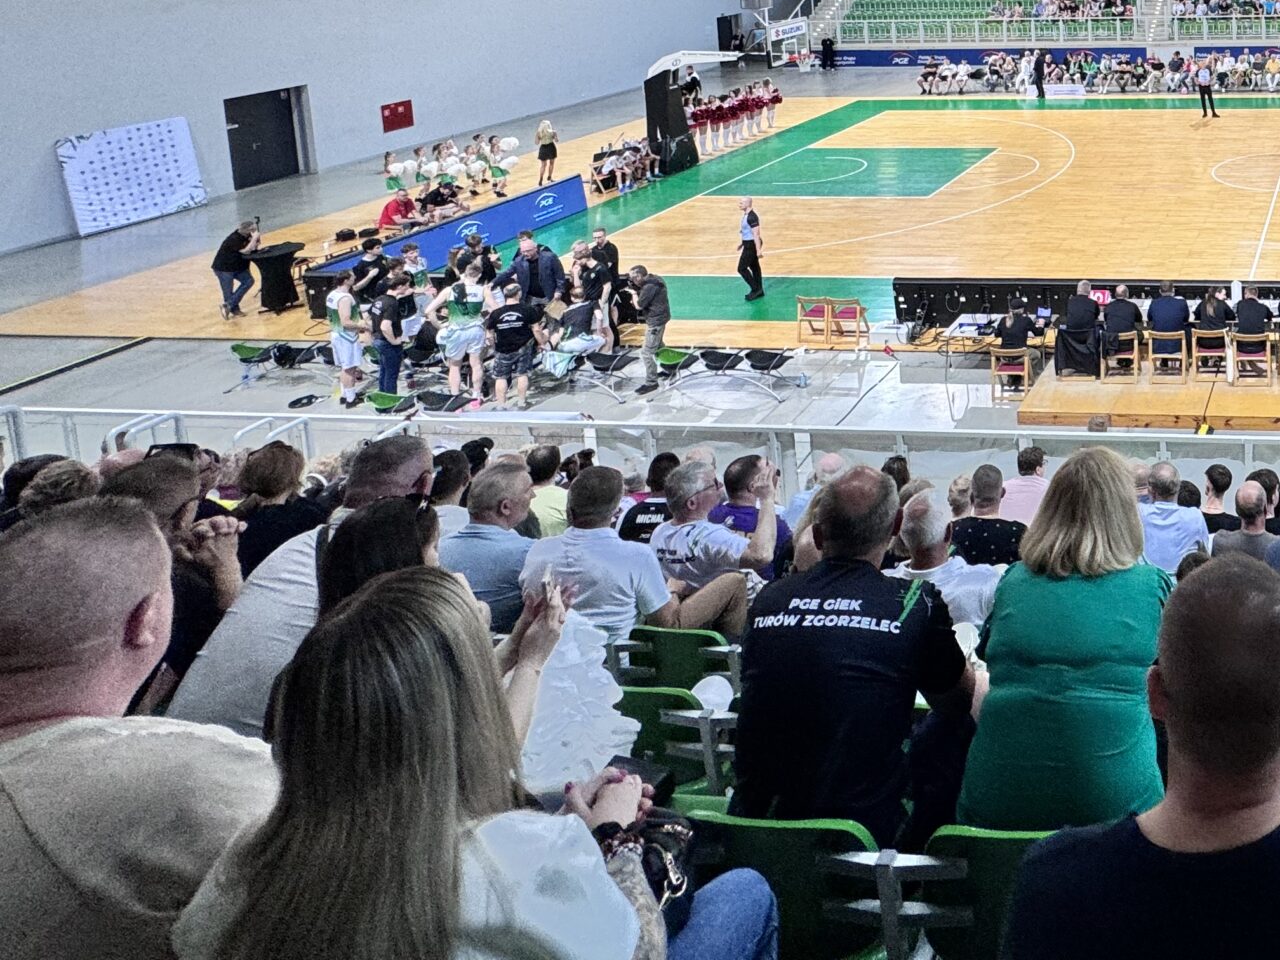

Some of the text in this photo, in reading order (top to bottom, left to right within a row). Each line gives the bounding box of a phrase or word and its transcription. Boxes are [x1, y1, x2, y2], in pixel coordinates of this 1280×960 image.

[781, 25, 803, 36] SUZUKI
[788, 598, 862, 611] PGE GiEK
[754, 611, 901, 634] TURÓW ZGORZELEC
